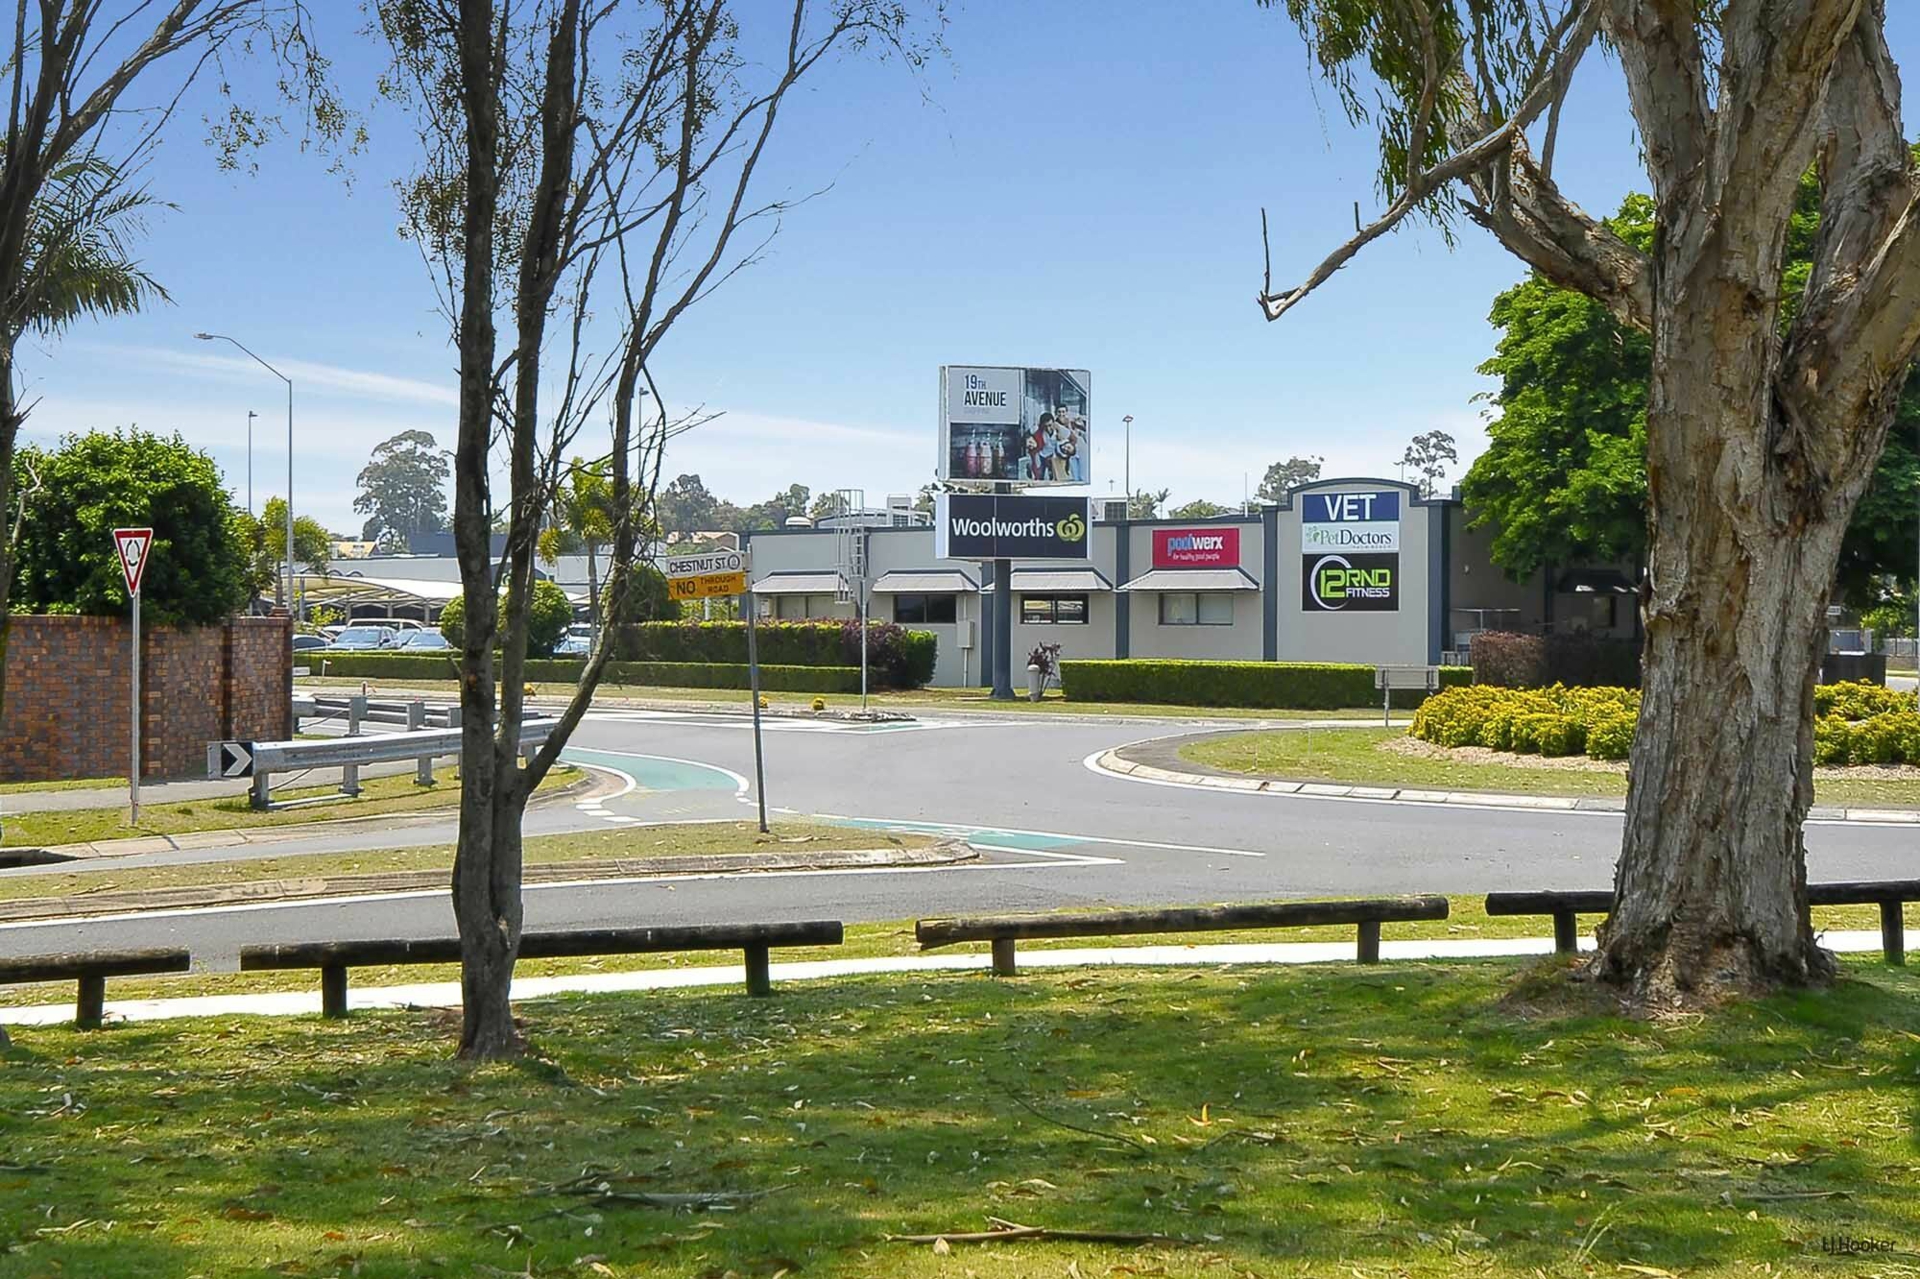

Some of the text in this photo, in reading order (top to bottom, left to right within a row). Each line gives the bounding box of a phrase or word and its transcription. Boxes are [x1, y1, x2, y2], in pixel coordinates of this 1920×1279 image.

[964, 391, 1007, 407] AVENUE
[1324, 494, 1377, 521] VET
[951, 516, 1055, 537] Woolworths
[1167, 533, 1224, 557] poolwerx
[669, 559, 714, 573] CHESTNUT
[676, 580, 696, 596] NO
[700, 575, 737, 585] THROUGH
[707, 585, 730, 594] ROAD
[1345, 587, 1391, 598] FITNESS
